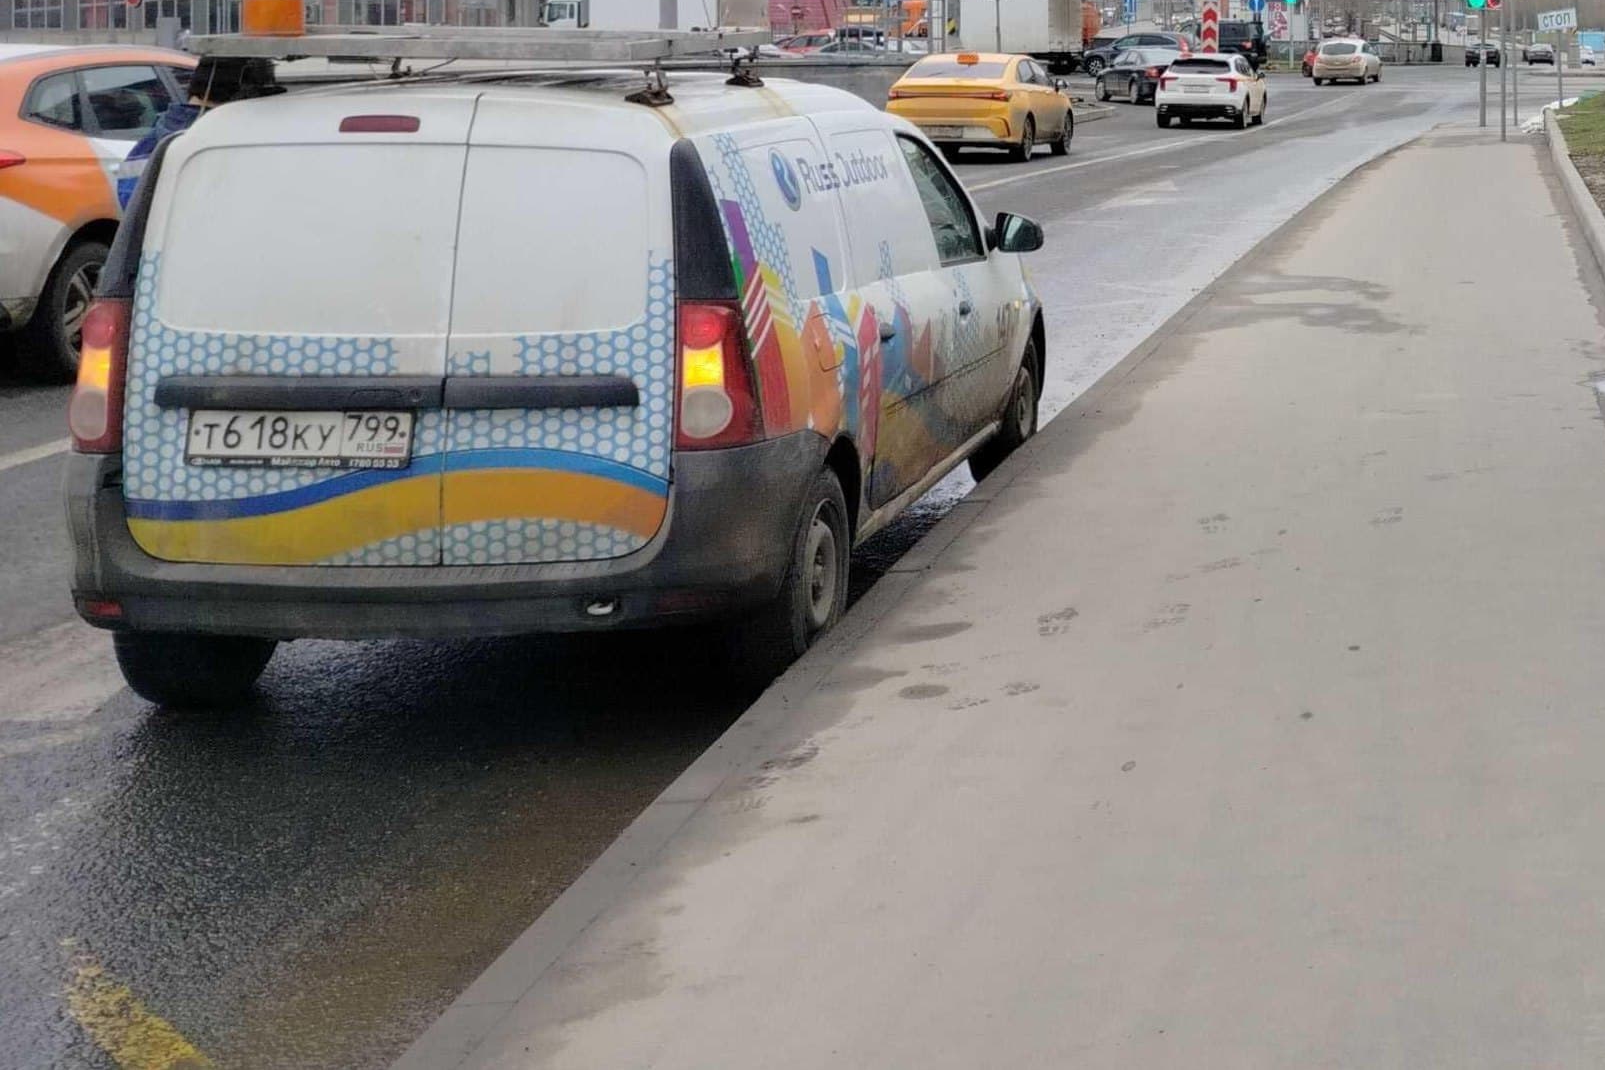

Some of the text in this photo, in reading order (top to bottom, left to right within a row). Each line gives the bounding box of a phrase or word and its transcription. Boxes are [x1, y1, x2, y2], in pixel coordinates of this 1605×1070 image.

[1542, 12, 1571, 28] СТОП
[796, 148, 889, 194] Russ Outdoor
[347, 414, 400, 442] 799
[356, 442, 383, 453] RUS
